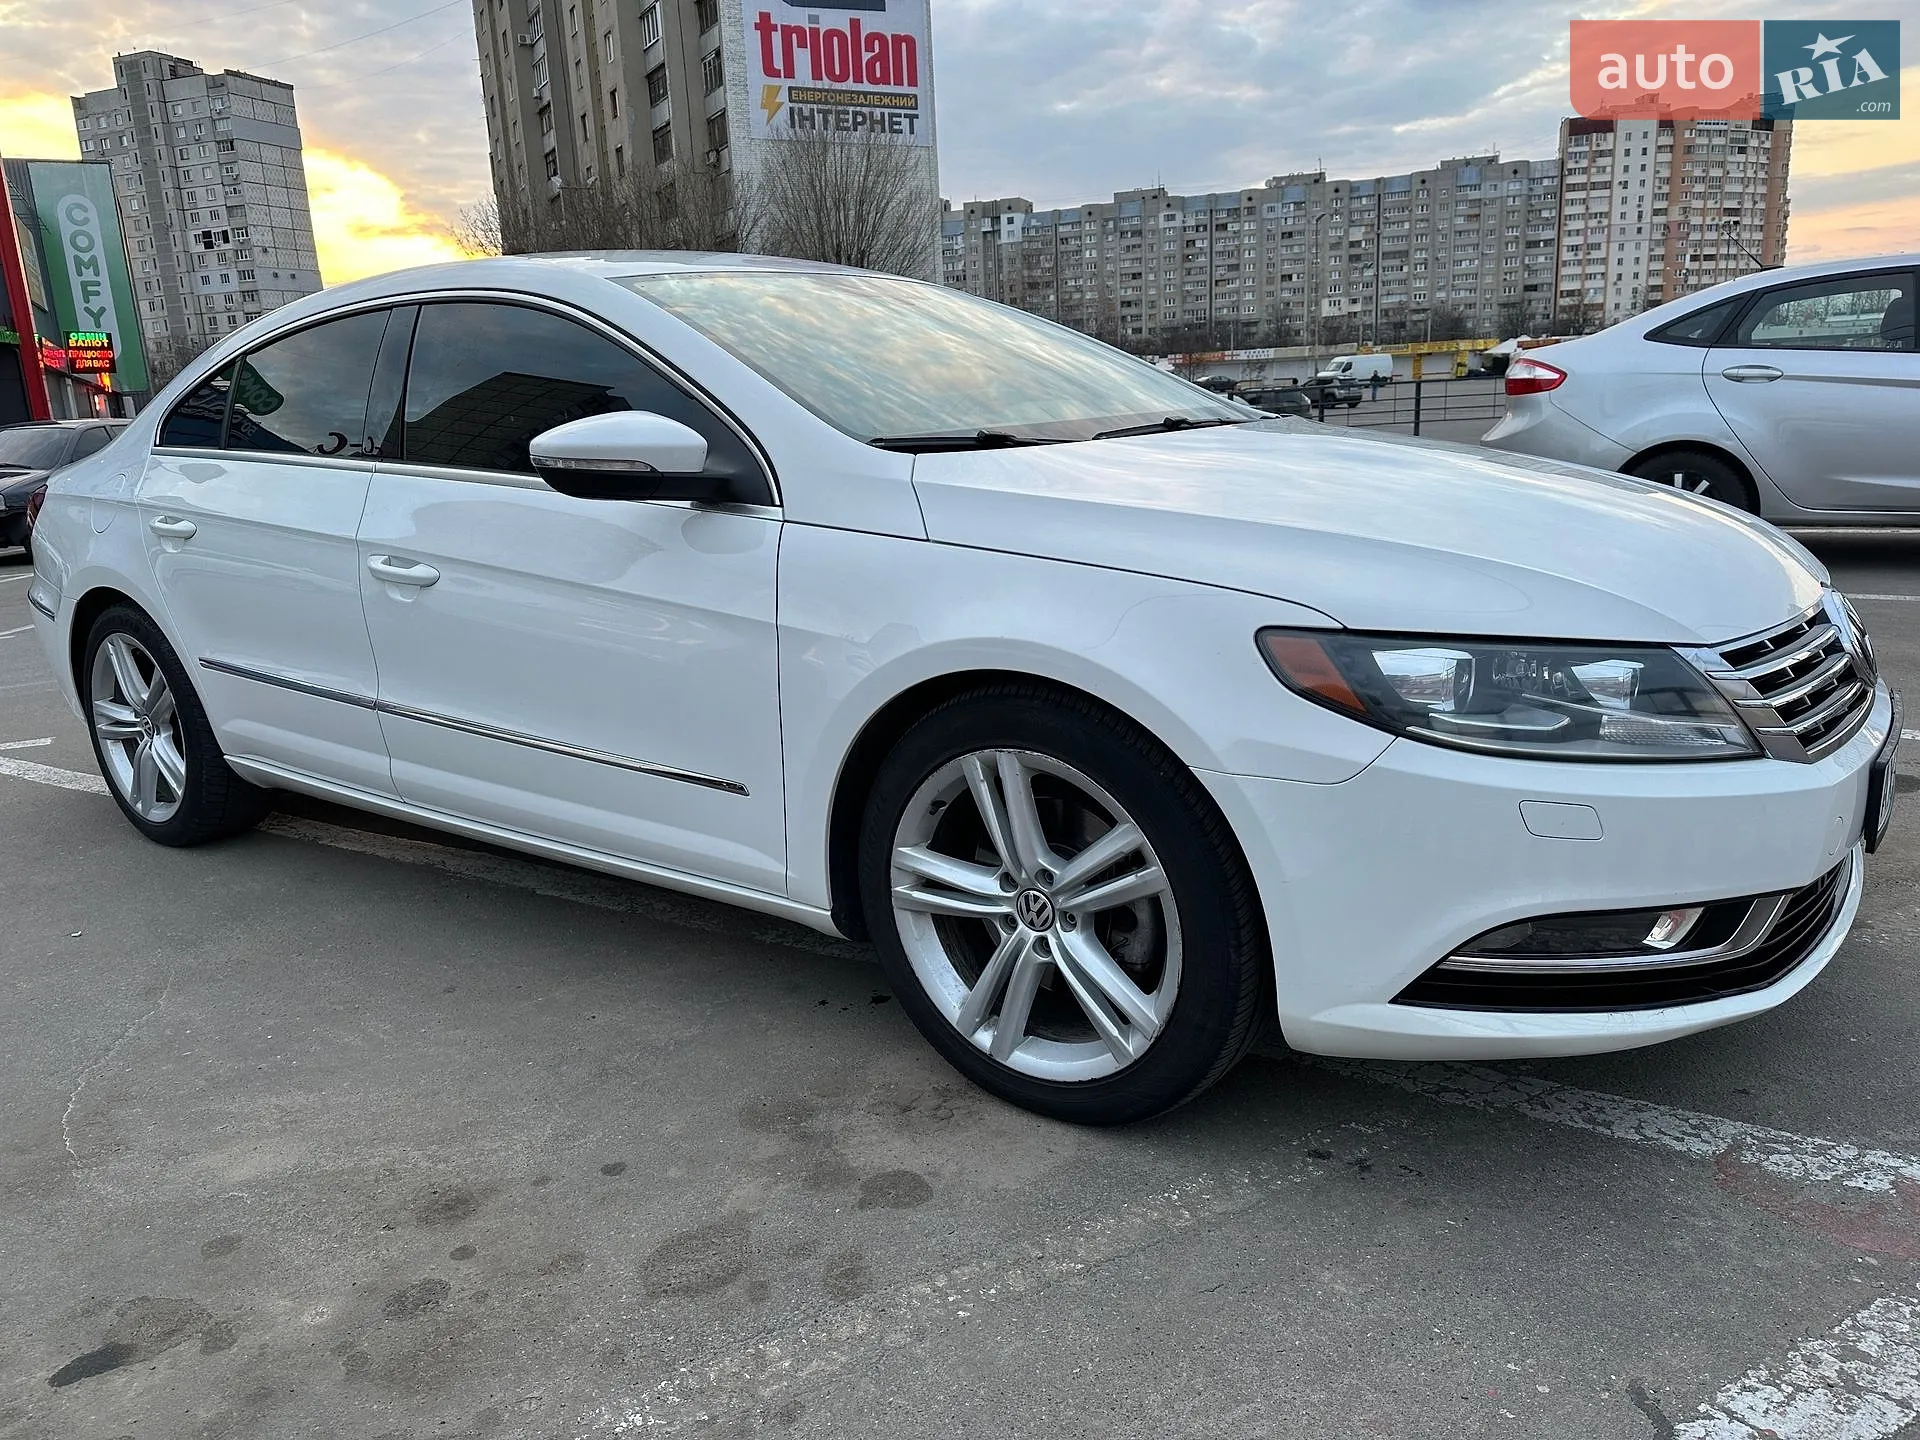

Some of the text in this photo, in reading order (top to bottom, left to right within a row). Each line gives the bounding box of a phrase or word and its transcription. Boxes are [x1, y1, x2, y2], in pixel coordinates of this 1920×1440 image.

[754, 11, 919, 88] triolan
[791, 90, 916, 107] ЕНЕРГОНЕЗАЛЕЖНИЙ
[789, 106, 920, 135] ІНТЕРНЕТ
[64, 202, 107, 330] COMFY
[68, 339, 109, 347] ВАЛЮТ
[69, 332, 107, 340] ОБМІН
[76, 360, 110, 369] ДЛЯ ВАС
